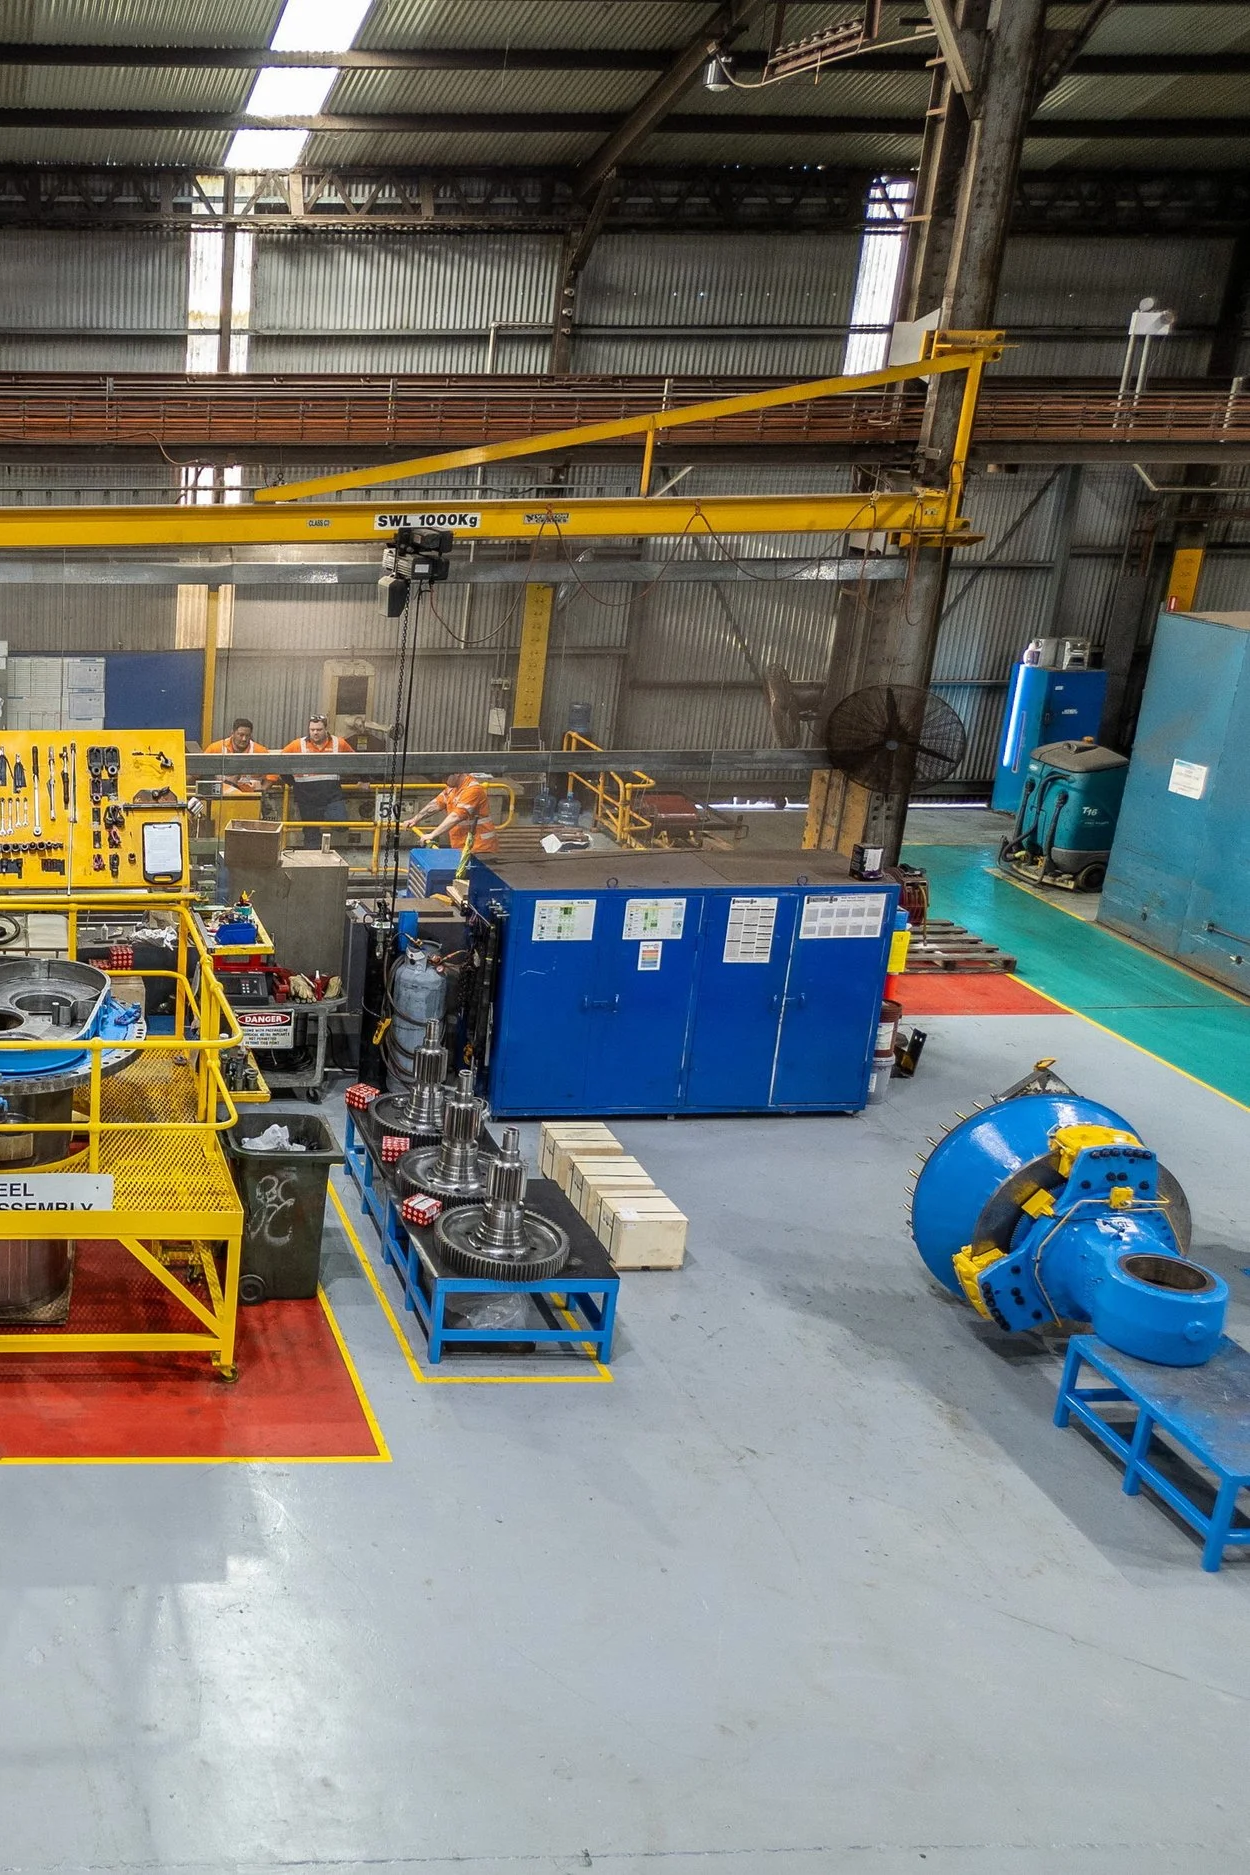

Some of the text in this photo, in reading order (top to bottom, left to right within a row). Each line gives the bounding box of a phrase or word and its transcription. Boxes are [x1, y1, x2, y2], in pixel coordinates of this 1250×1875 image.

[308, 519, 324, 527] CLASS
[377, 513, 478, 527] SWL 1000Kg
